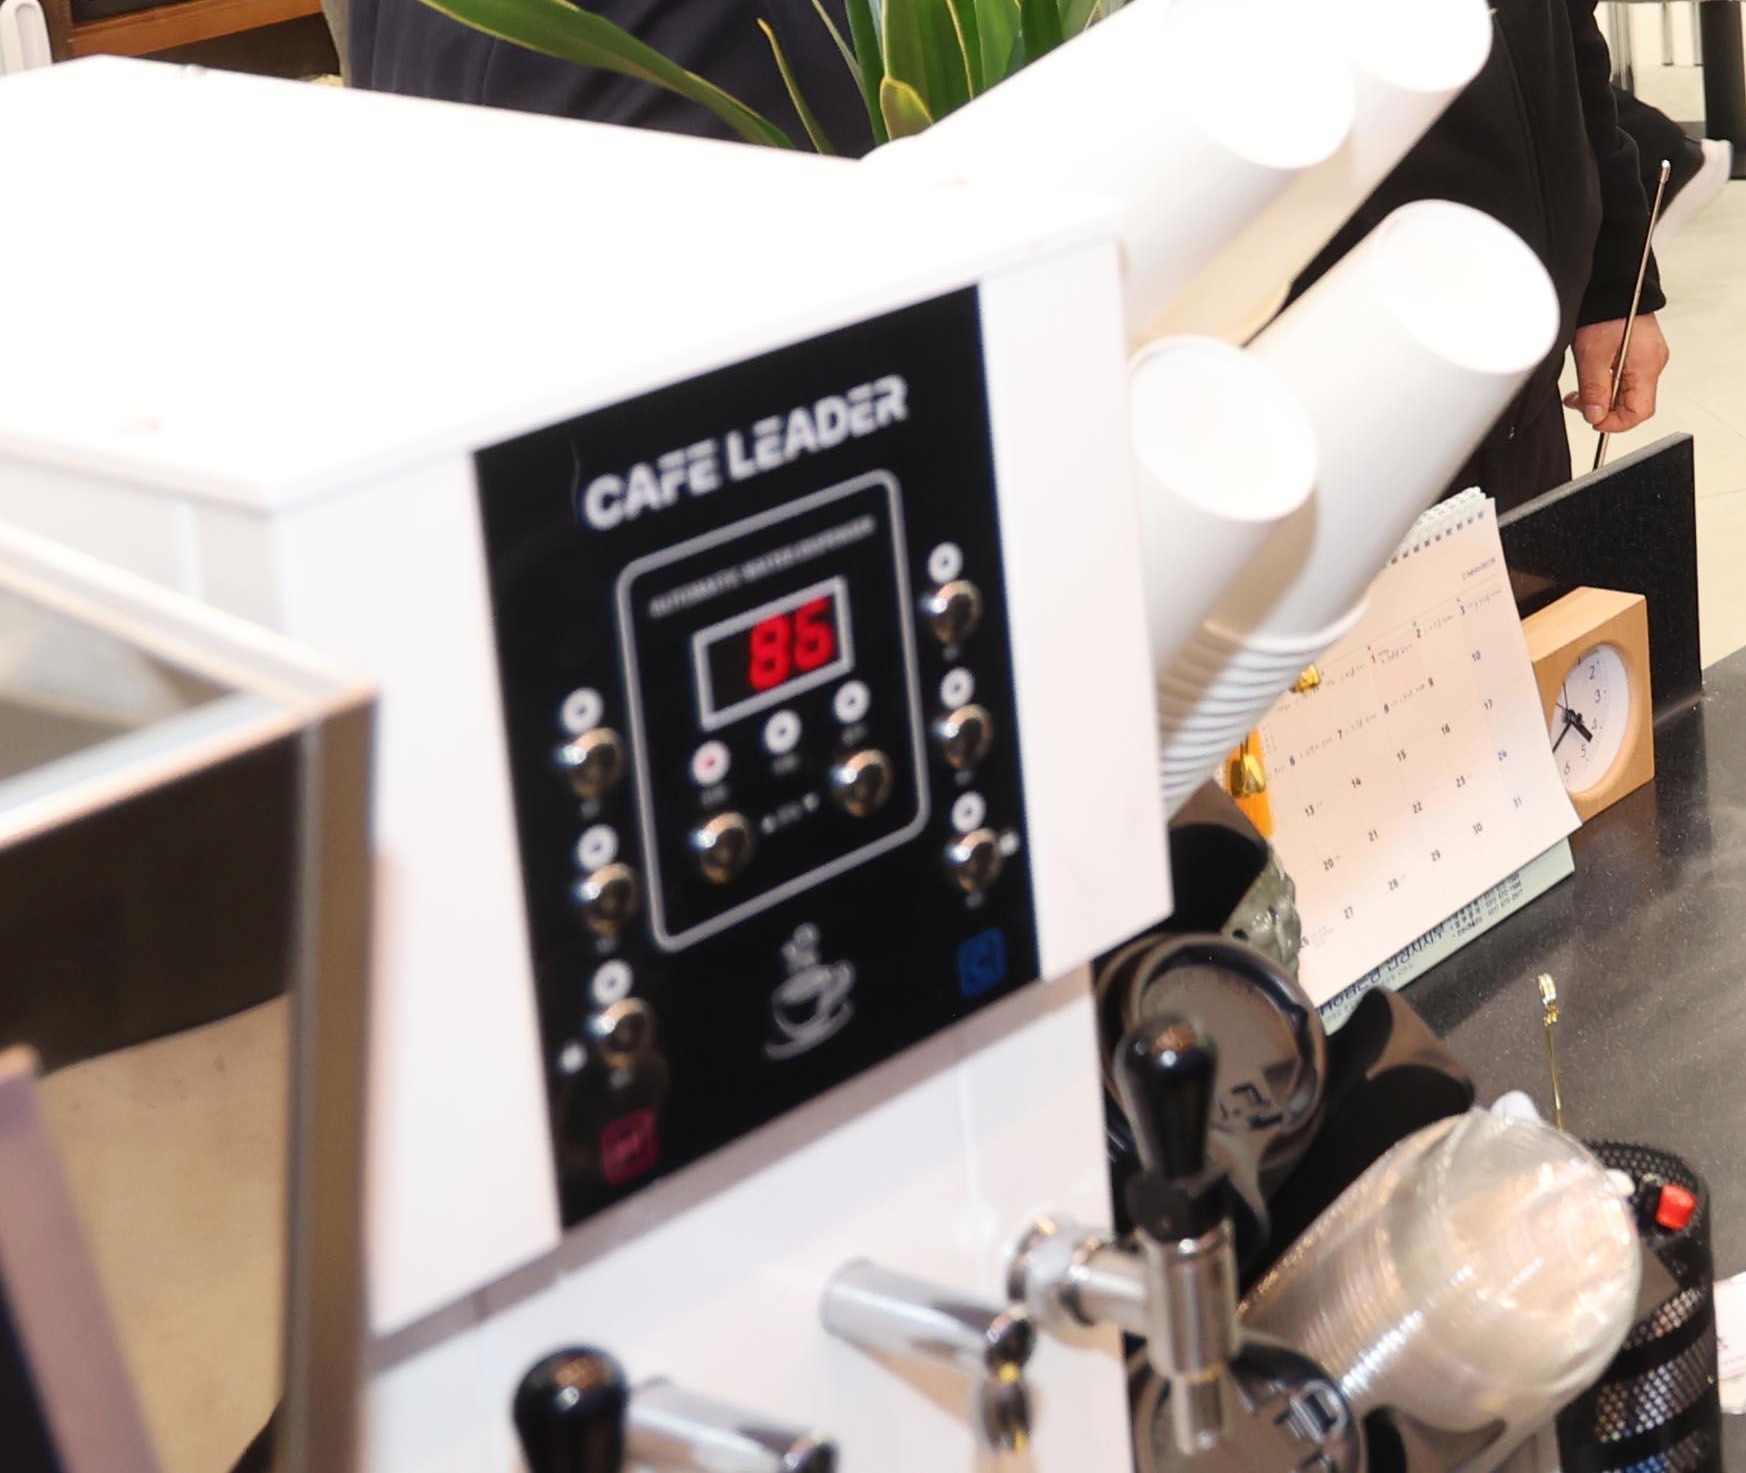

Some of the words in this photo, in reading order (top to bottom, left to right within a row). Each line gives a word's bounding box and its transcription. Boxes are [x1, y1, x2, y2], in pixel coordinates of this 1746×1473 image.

[584, 437, 720, 530] CAFE
[727, 374, 909, 482] LEADER
[748, 594, 834, 693] 86
[1472, 649, 1482, 662] 10
[1589, 665, 1595, 681] 2
[1594, 689, 1601, 704] 3
[1305, 804, 1315, 816] 13
[1351, 777, 1362, 788] 14
[1396, 749, 1407, 761] 15
[1441, 723, 1451, 735] 16
[1483, 697, 1493, 710] 17
[1564, 761, 1571, 775] 6
[1580, 744, 1587, 758] 5
[1323, 858, 1334, 871] 20
[1368, 830, 1379, 843] 21
[1412, 801, 1423, 814] 22
[1456, 774, 1466, 788] 23
[1343, 905, 1354, 920] 27
[1472, 822, 1483, 835] 30
[1512, 796, 1523, 809] 31
